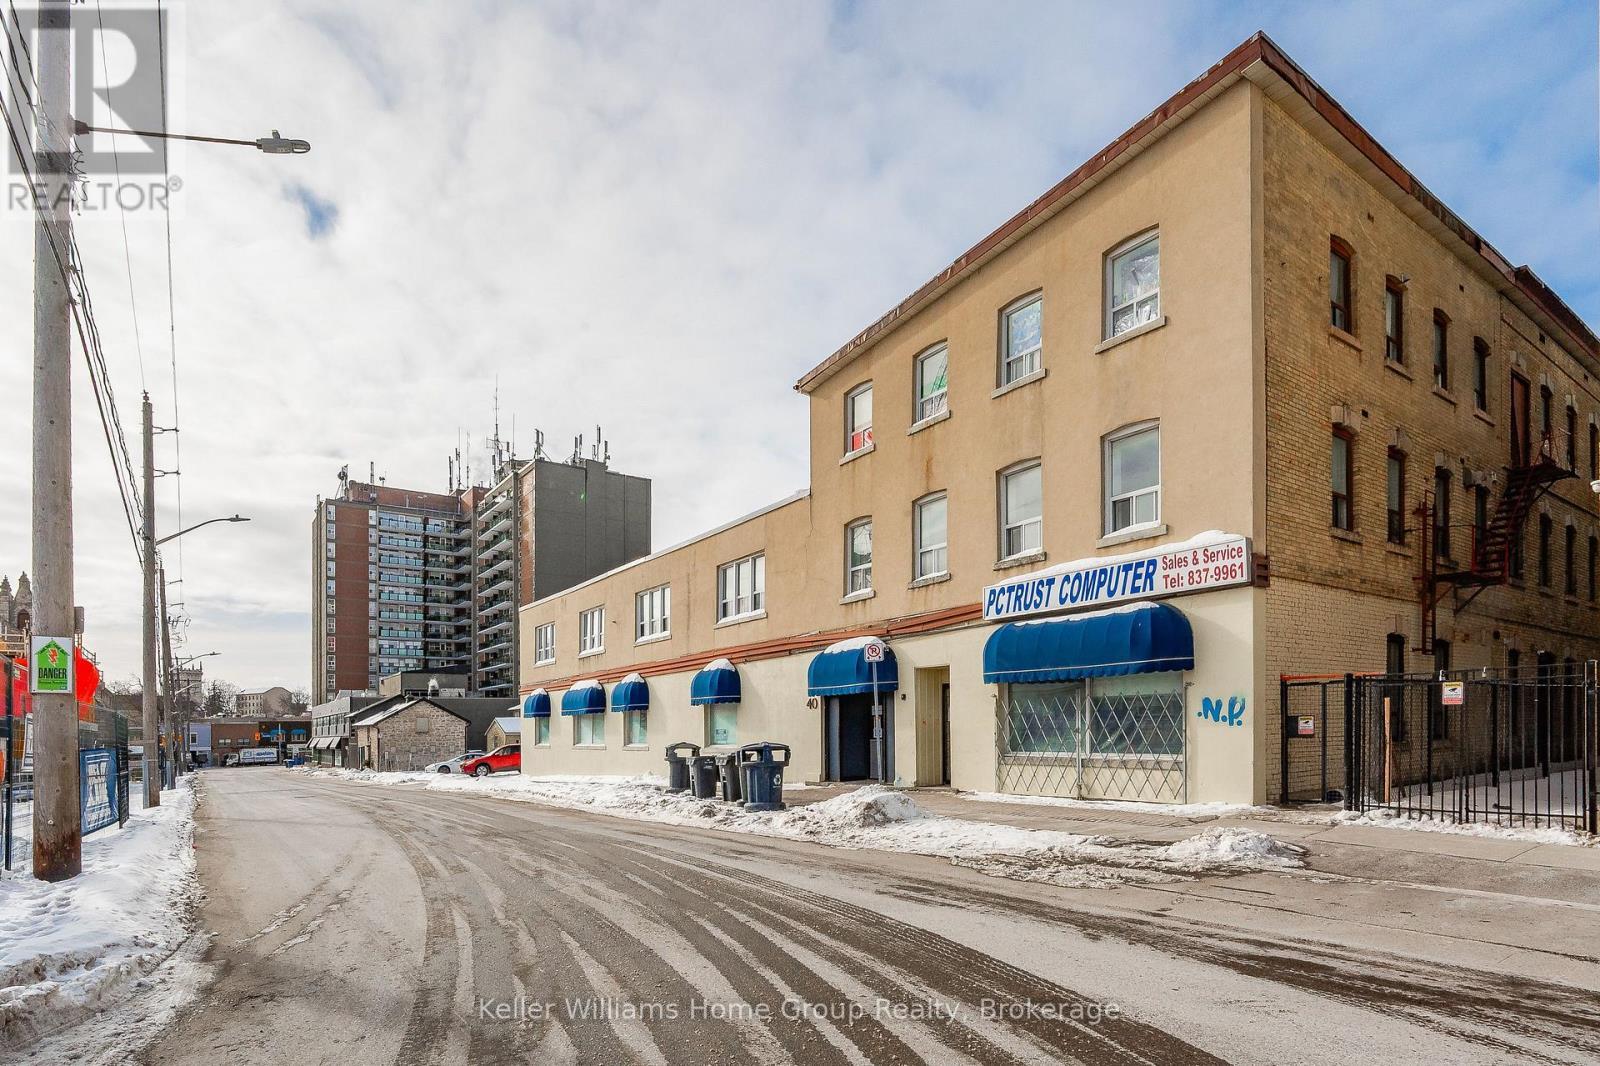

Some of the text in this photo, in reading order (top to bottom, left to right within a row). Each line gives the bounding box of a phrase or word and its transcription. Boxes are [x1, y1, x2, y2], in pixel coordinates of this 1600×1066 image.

[1161, 545, 1243, 571] Sales & Service
[985, 558, 1158, 617] PCTRUST COMPUTER
[1163, 561, 1245, 590] Tel: 837-9961
[38, 667, 67, 679] DANGER
[806, 698, 817, 709] 40
